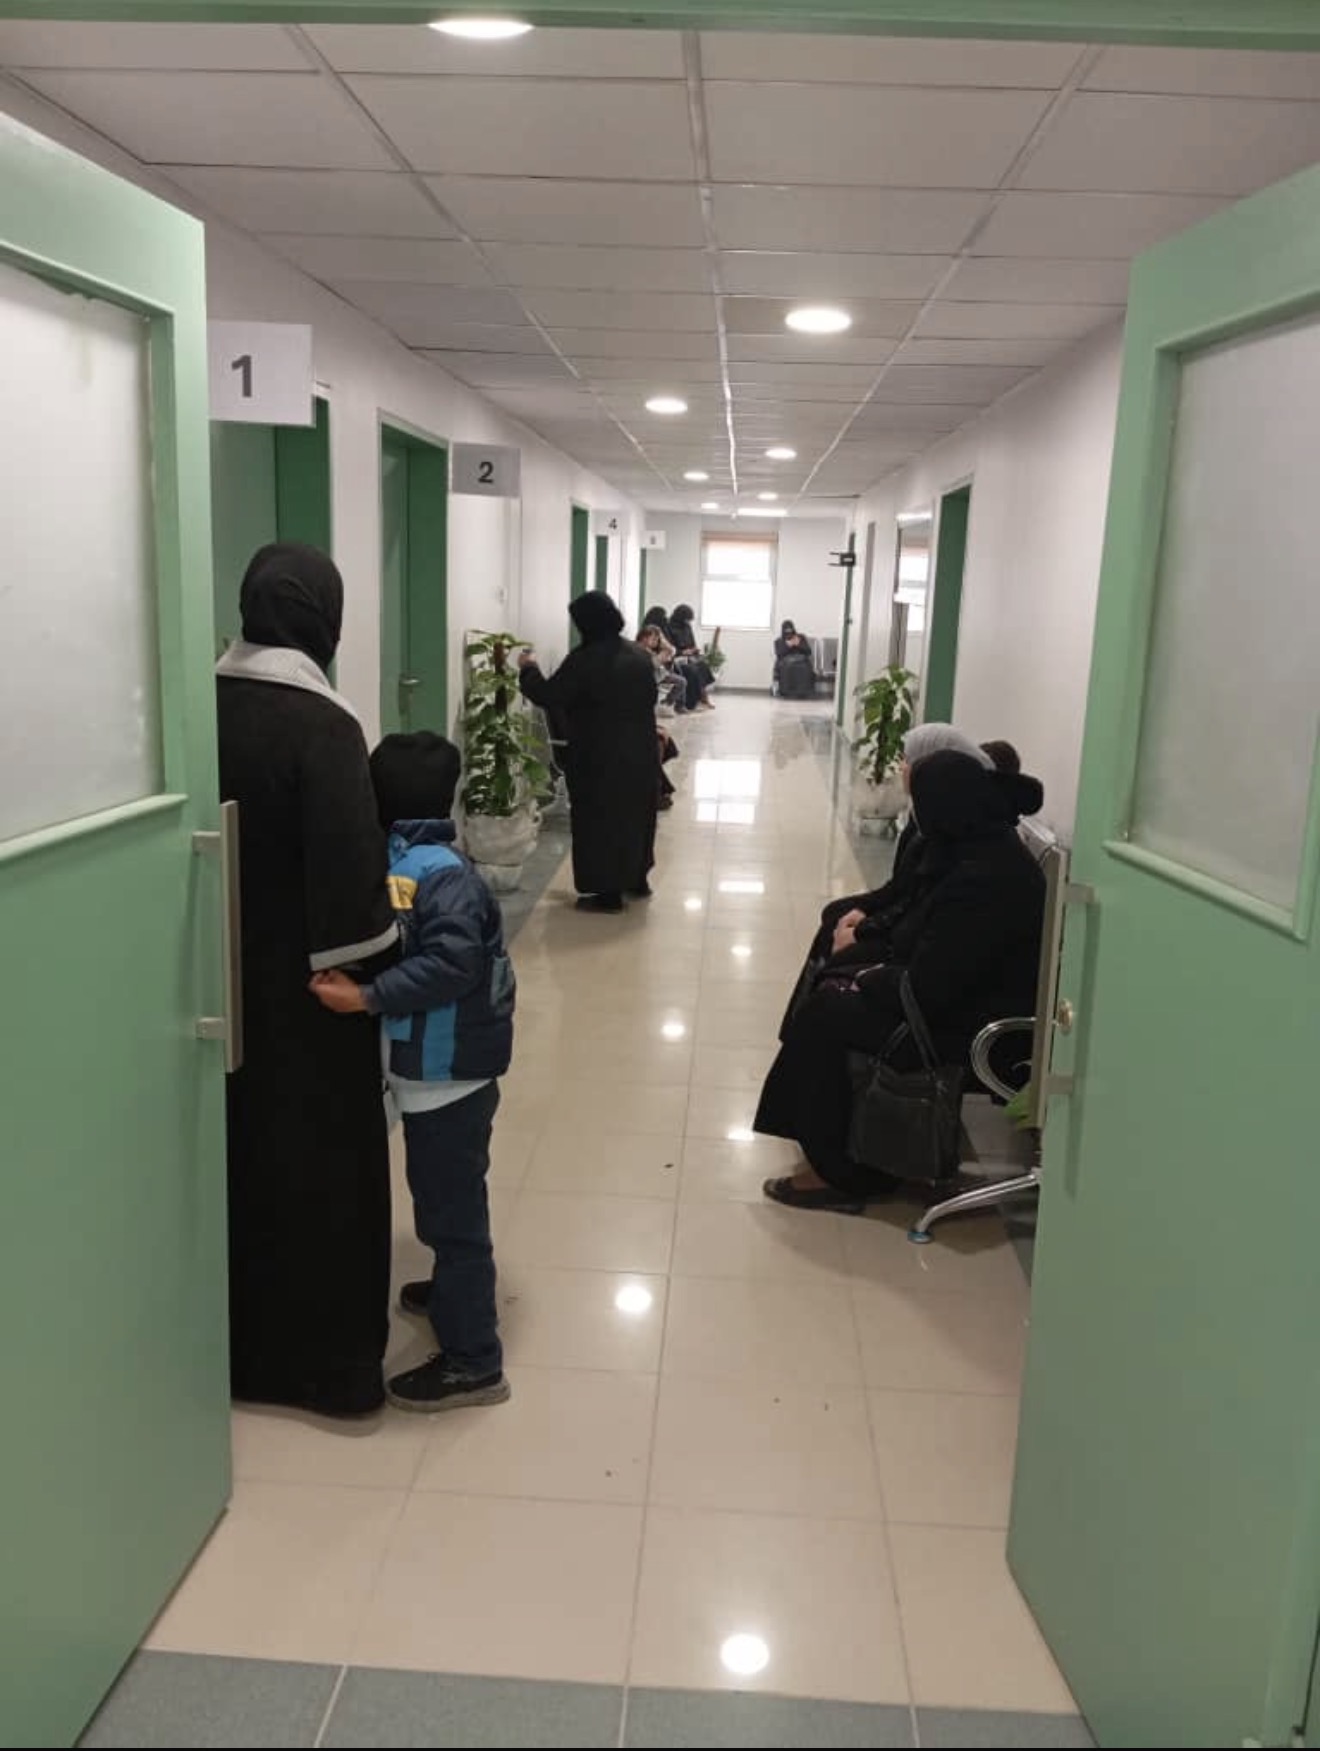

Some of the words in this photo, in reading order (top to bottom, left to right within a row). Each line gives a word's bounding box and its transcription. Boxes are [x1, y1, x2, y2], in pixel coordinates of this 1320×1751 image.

[231, 354, 252, 398] 1
[478, 461, 494, 484] 2
[608, 517, 618, 530] 4
